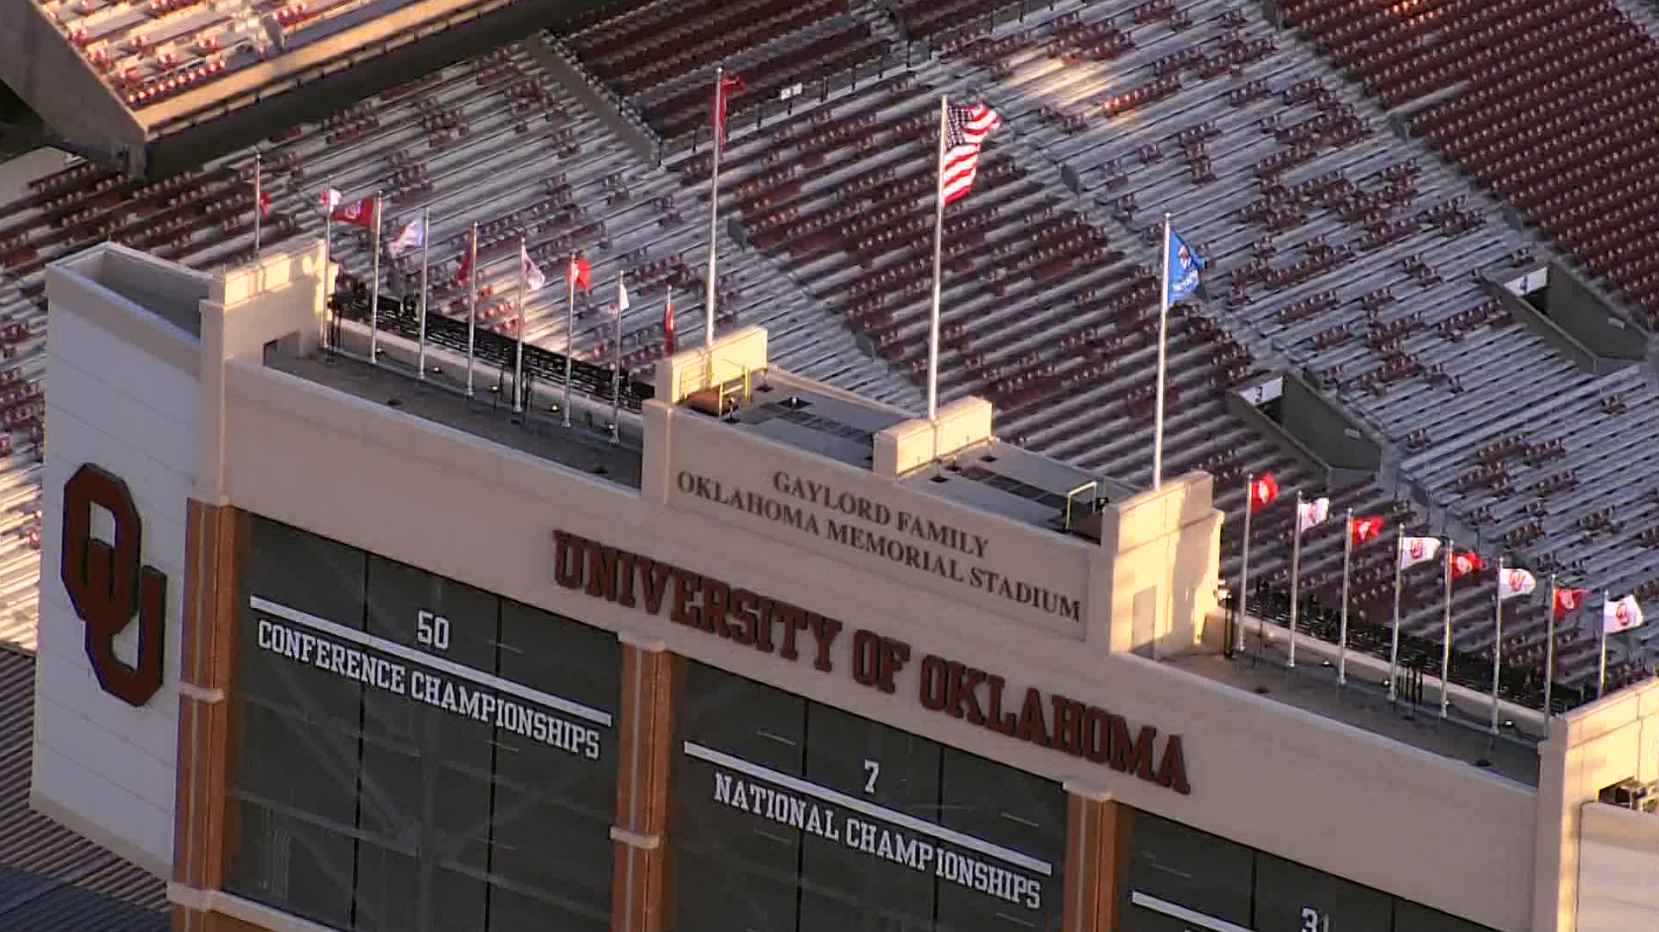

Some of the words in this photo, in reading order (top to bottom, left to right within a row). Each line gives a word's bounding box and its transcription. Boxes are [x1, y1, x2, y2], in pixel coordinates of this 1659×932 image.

[61, 461, 168, 708] OU
[677, 470, 819, 536] OKLAHOMA
[826, 519, 963, 583] MEMORIAL
[970, 566, 1080, 623] STADIUM
[773, 471, 890, 525] GAYLORD
[899, 516, 989, 559] FAMILY
[258, 619, 405, 695] CONFERENCE
[411, 670, 600, 760] CHAMPIONSHIPS
[416, 609, 449, 649] 50
[551, 529, 843, 673] UNIVERSITY
[852, 629, 911, 695] OF
[919, 653, 1191, 796] OKLAHOMA
[713, 771, 839, 842] NATIONAL
[845, 816, 1041, 909] CHAMPIONSHIPS
[864, 758, 880, 794] 7
